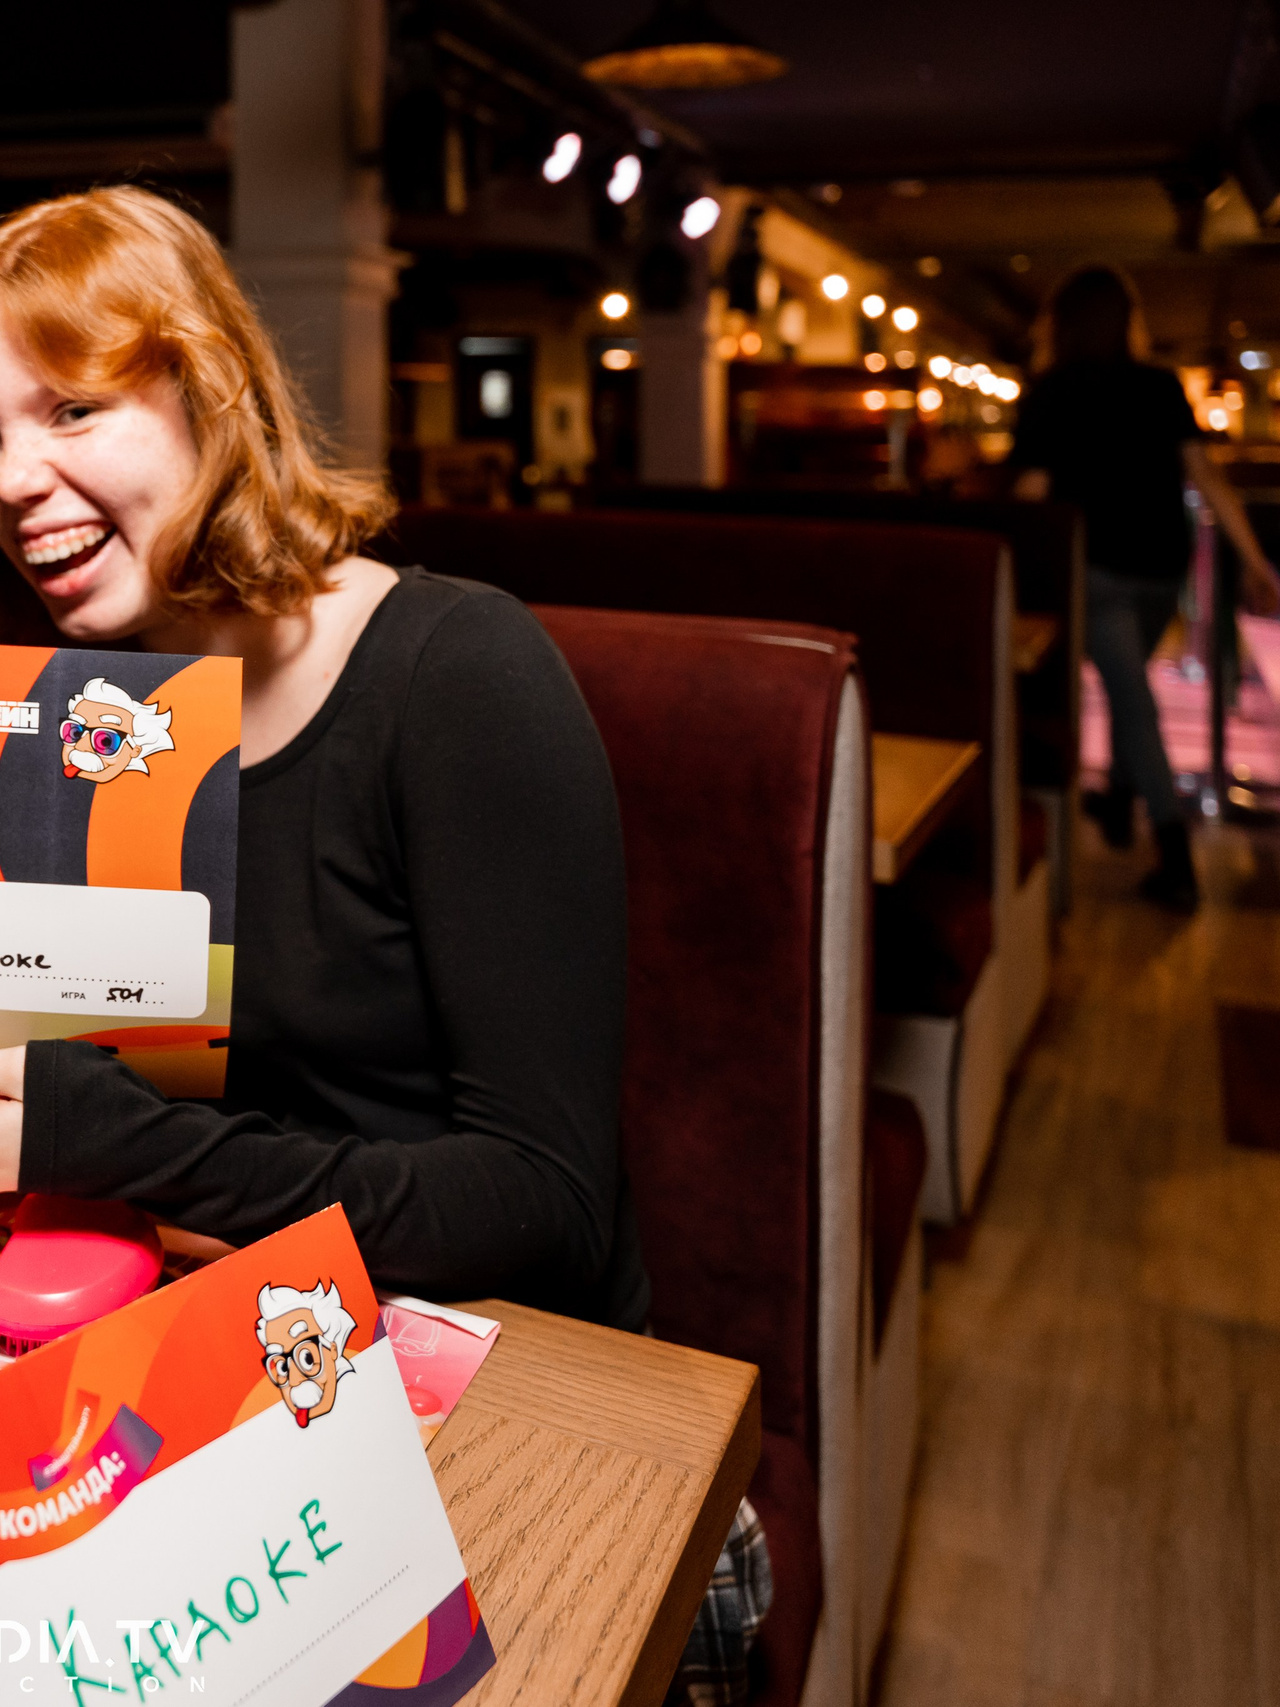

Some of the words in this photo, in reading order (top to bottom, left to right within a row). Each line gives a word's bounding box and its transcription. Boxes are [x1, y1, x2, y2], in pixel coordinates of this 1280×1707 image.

[61, 991, 87, 1001] ИГРА
[106, 987, 144, 1003] 501
[46, 1498, 342, 1707] КАРАОКЕ
